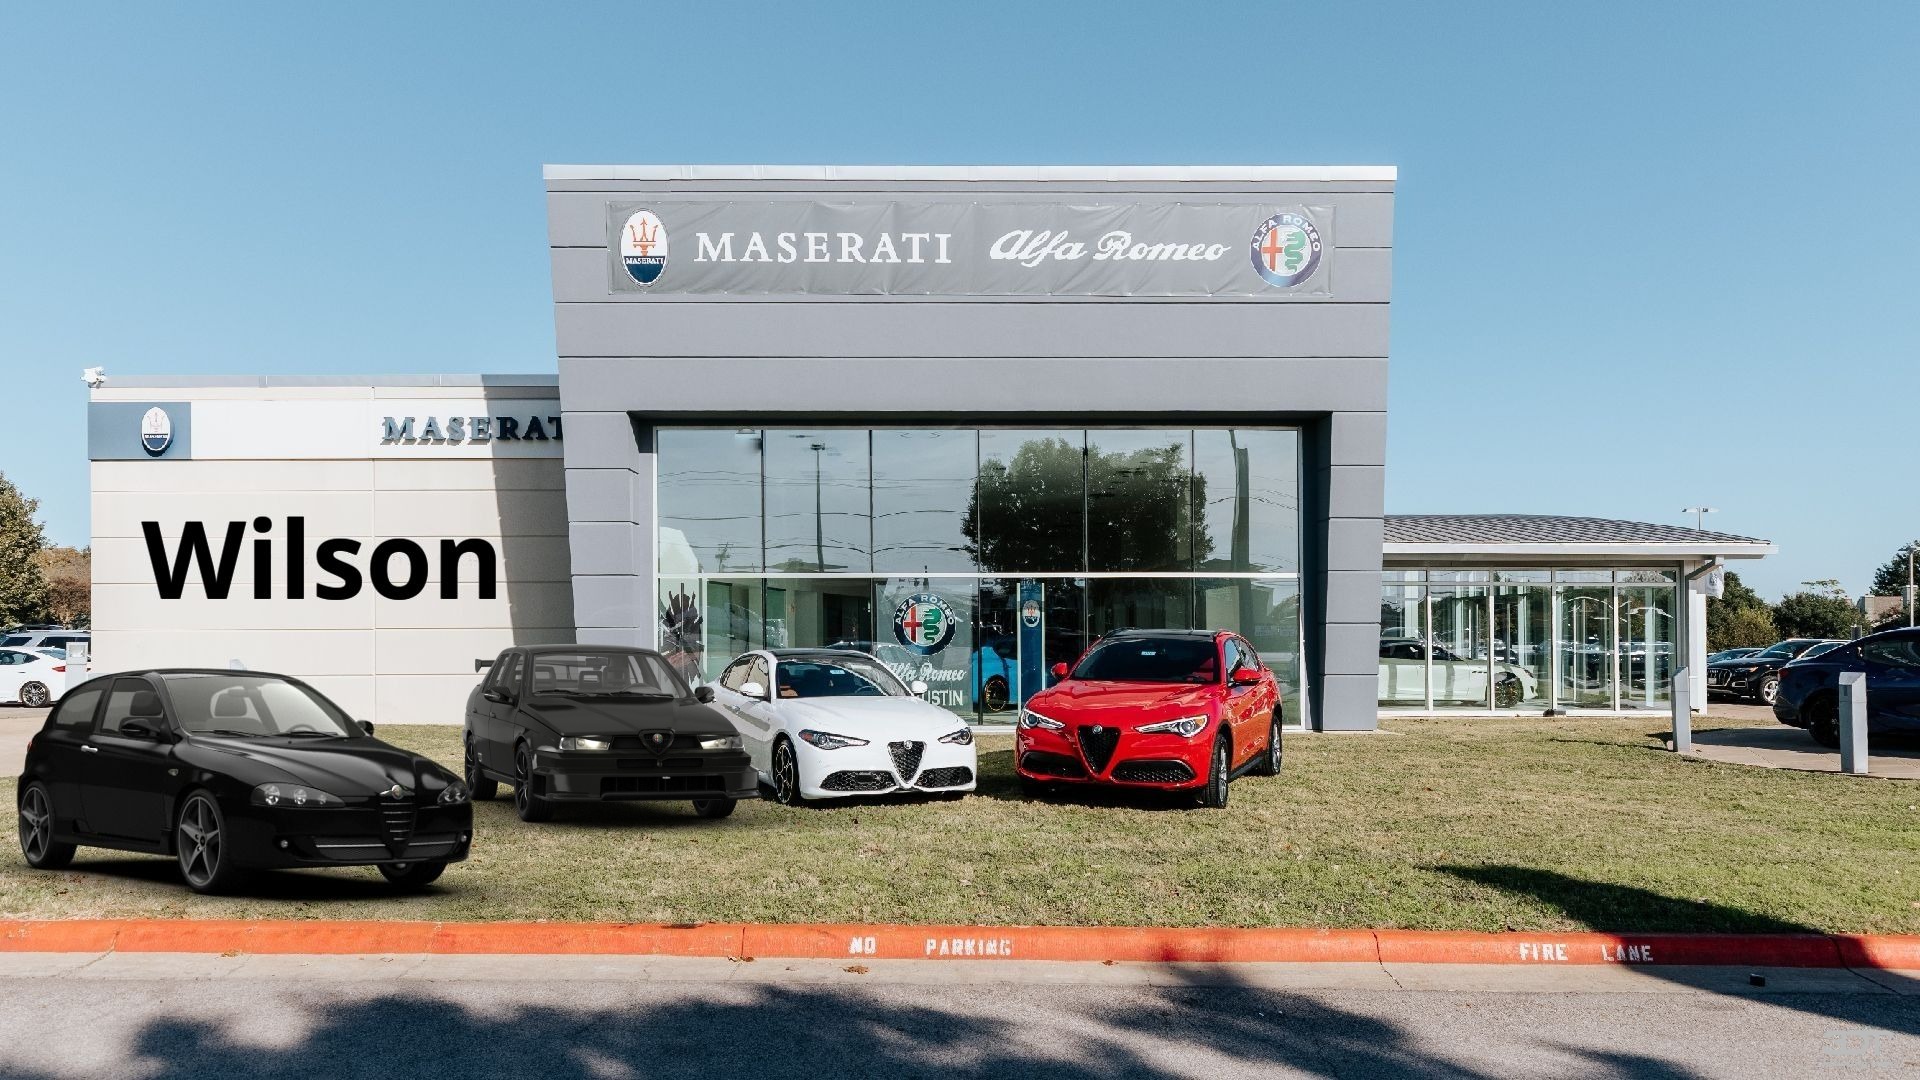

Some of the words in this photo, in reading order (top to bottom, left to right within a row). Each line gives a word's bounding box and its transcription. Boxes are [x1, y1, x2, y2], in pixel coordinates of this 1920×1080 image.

[1252, 219, 1278, 252] ALFA
[1282, 214, 1321, 252] ROMEO
[693, 232, 951, 263] MASERATI
[989, 229, 1088, 267] Alfa
[1093, 230, 1231, 261] Romeo
[625, 257, 664, 265] MASERATI
[381, 416, 563, 444] MASERAT
[895, 598, 917, 625] ALFA
[920, 594, 955, 625] ROMEO
[919, 662, 967, 682] Romeo
[919, 689, 964, 706] USTIN
[849, 936, 877, 955] NO
[925, 938, 1013, 956] PARKING
[1519, 942, 1569, 961] FIRE
[1600, 943, 1654, 962] LANE
